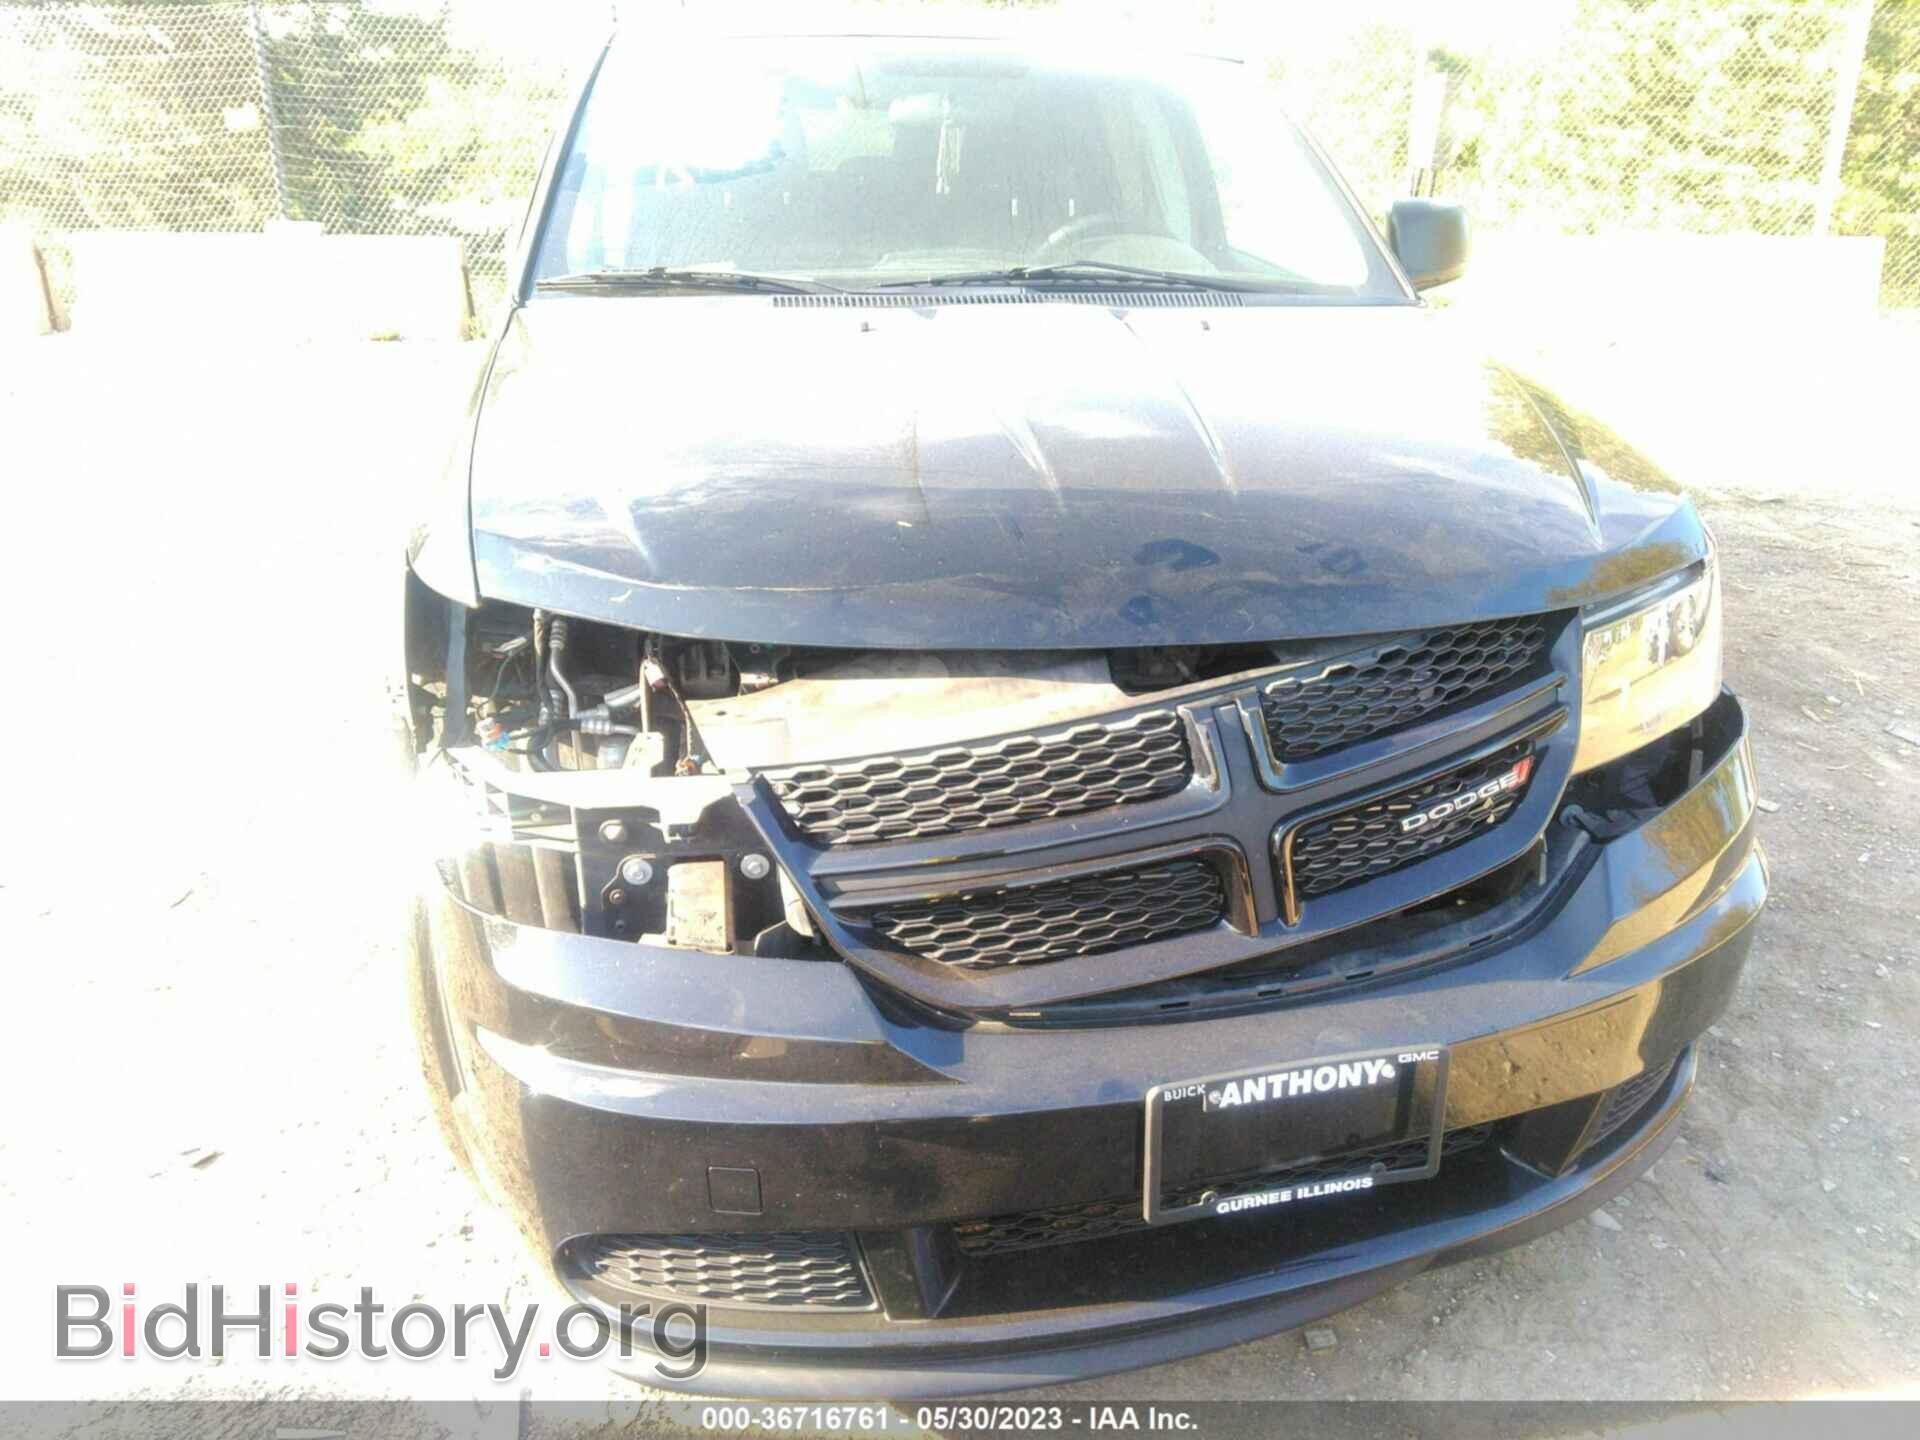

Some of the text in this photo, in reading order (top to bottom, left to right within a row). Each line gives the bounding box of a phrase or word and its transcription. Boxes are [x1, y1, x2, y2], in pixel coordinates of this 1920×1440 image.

[1401, 772, 1519, 831] DODGE
[1398, 1050, 1439, 1064] GMC
[1164, 1083, 1206, 1102] BUICK
[1219, 1059, 1386, 1108] ANTHONY
[1216, 1176, 1374, 1215] GURNEE ILLINOIS
